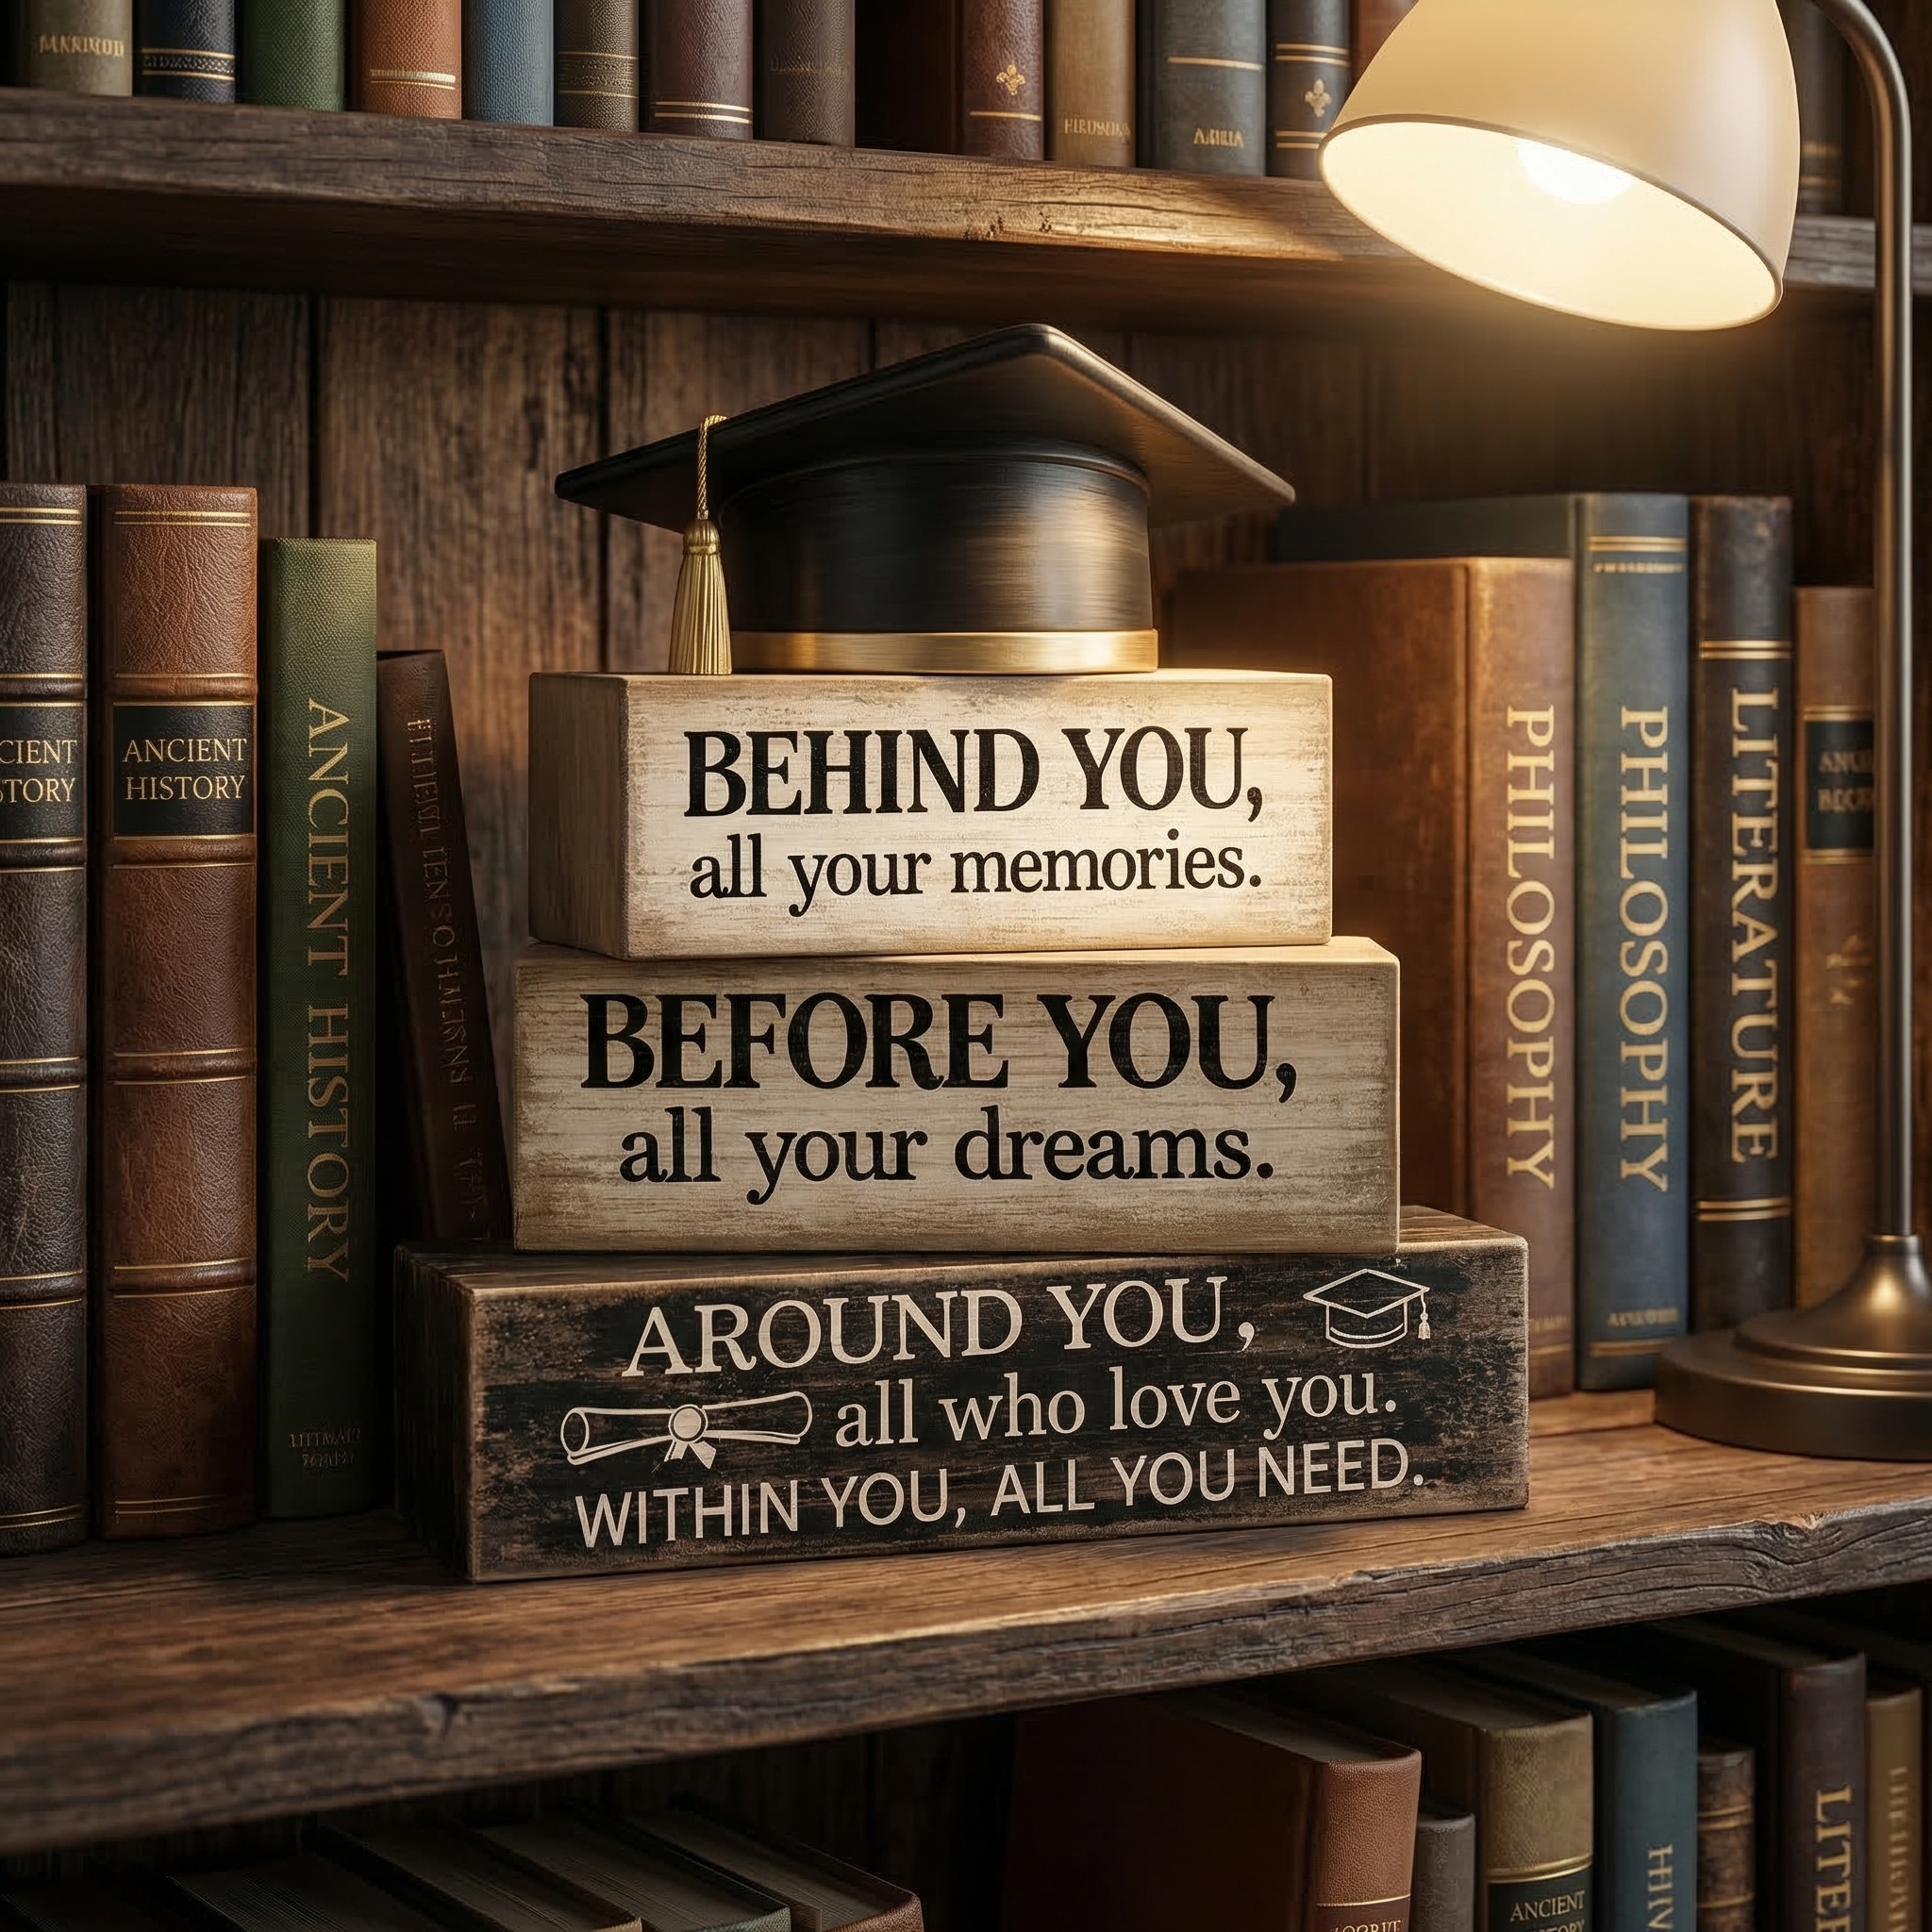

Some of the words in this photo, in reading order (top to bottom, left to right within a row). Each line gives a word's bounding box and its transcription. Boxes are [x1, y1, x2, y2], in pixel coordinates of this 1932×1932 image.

[0, 777, 75, 803] TORY
[122, 738, 247, 764] ANCIENT
[125, 774, 246, 801] HISTORY
[683, 728, 1041, 818] BEHIND
[1060, 725, 1263, 824] YOU,
[308, 698, 350, 975] ANCIENT
[690, 832, 768, 899] all
[787, 851, 932, 918] your
[950, 828, 1262, 893] memories.
[1507, 705, 1556, 1190] PHILOSOPHY
[1620, 705, 1669, 1192] PHILOSOPHY
[1731, 688, 1778, 1162] LITERATURE
[579, 991, 1009, 1091] BEFORE
[1036, 991, 1298, 1105] YOU,
[308, 1005, 349, 1284] HISTORY
[619, 1105, 722, 1183] all
[744, 1130, 928, 1207] your
[954, 1105, 1274, 1182] dreams.
[621, 1289, 1023, 1377] AROUND
[1045, 1275, 1256, 1352] YOU,
[836, 1378, 919, 1448] all
[938, 1372, 1086, 1442] who
[1108, 1365, 1241, 1431] love
[1260, 1373, 1397, 1441] you.
[575, 1479, 799, 1549] WITHIN
[821, 1468, 967, 1529] YOU,
[990, 1458, 1096, 1517] ALL
[1109, 1448, 1236, 1507] YOU
[1257, 1438, 1424, 1498] NEED.
[1509, 1890, 1586, 1922] ANCIENT
